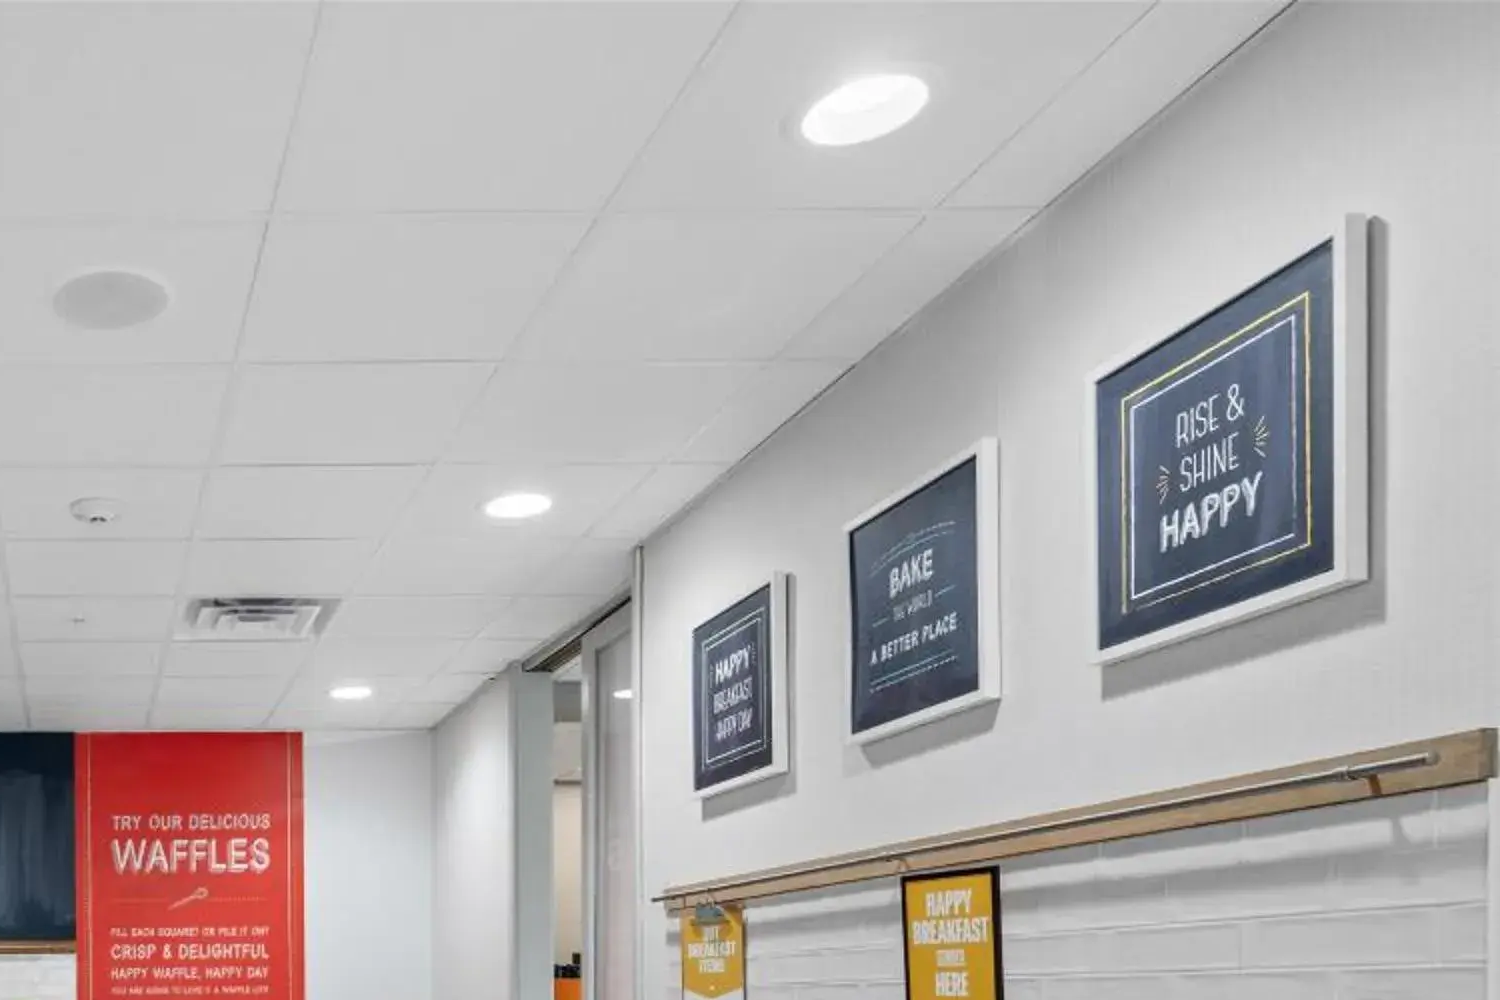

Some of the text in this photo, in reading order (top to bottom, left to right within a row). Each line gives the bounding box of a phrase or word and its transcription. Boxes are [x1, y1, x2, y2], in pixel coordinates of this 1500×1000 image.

[1176, 383, 1244, 448] RISE &
[1179, 432, 1239, 492] SHINE
[1160, 471, 1262, 553] HAPPY
[889, 548, 933, 598] BAKE
[870, 611, 957, 666] A BETTER PLACE
[715, 644, 751, 685] HAPPY
[112, 814, 271, 830] TRY OUR DELICIOUS
[111, 838, 271, 874] WAFFLES
[926, 889, 972, 917] HAPPY
[913, 917, 989, 945] BREAKFAST
[111, 943, 269, 960] CRISP & DELIGHTFUL
[111, 967, 148, 979] HAPPY
[205, 967, 245, 979] HAPPY
[247, 966, 269, 979] DAY
[936, 972, 969, 996] HERE
